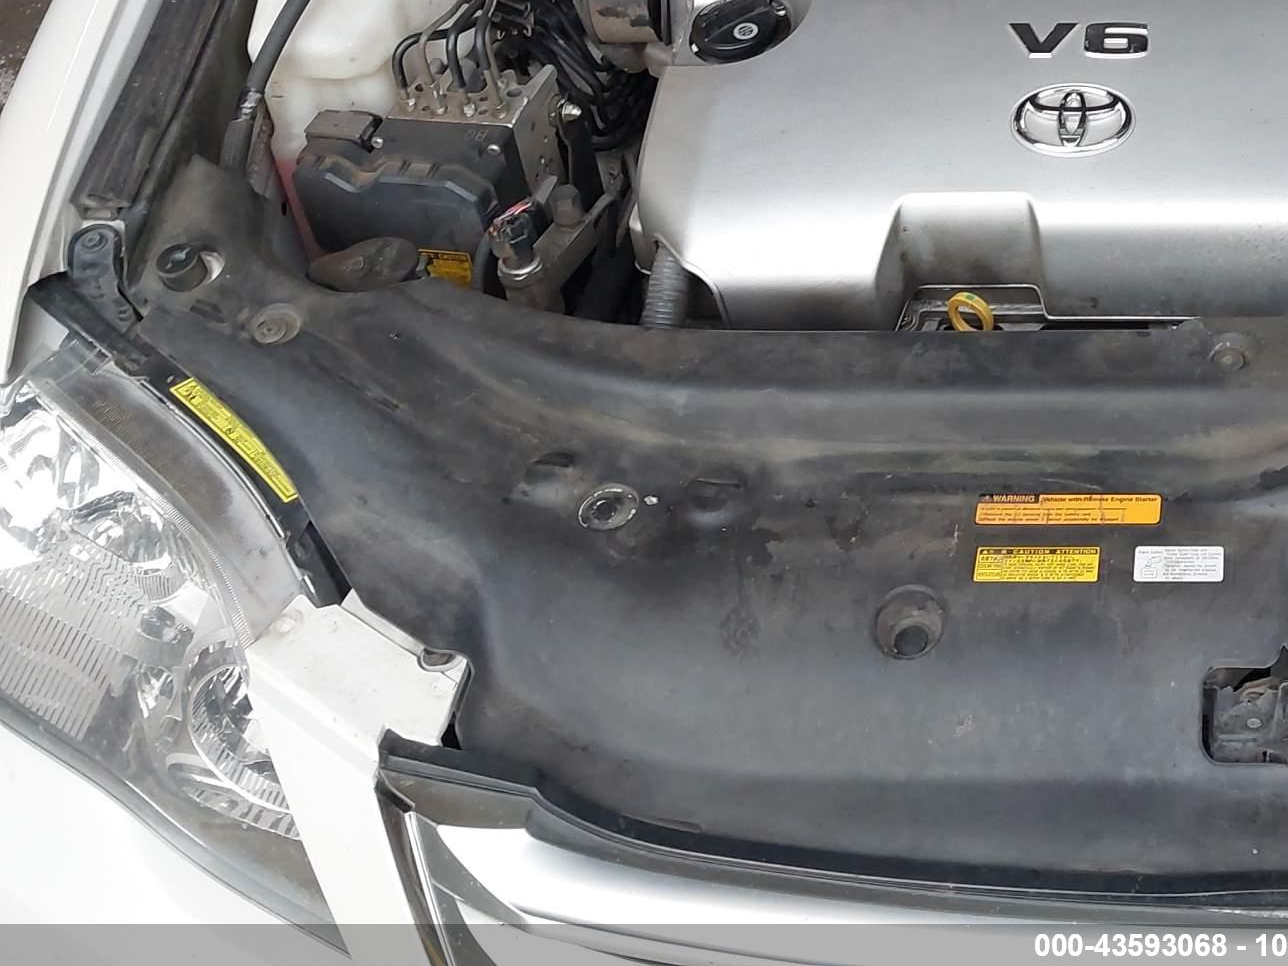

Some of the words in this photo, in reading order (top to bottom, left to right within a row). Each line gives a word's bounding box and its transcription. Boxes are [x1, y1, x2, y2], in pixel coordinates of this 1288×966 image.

[1009, 22, 1149, 59] V6
[992, 494, 1036, 503] WARNING
[1110, 496, 1134, 504] Engine
